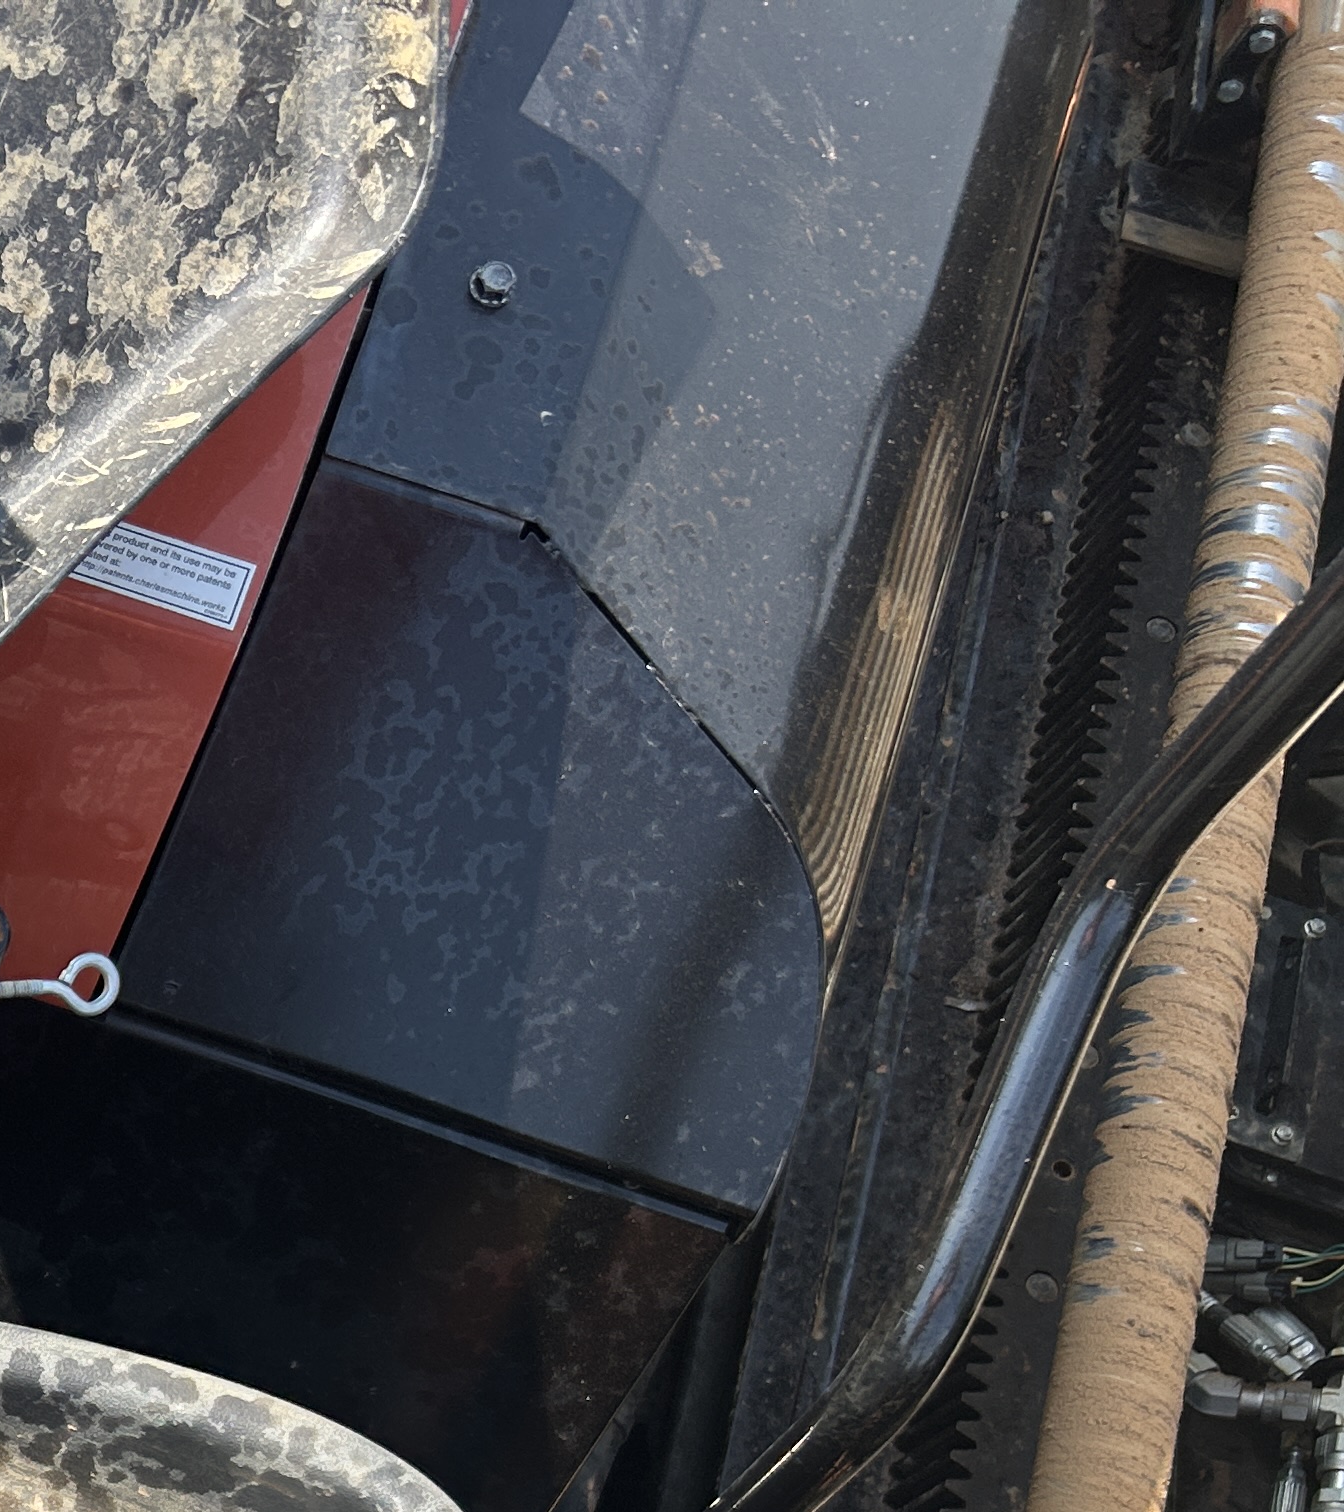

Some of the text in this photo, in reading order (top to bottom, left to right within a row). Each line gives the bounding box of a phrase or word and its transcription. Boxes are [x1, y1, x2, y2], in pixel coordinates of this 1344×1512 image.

[98, 541, 232, 590] vered by one or more patents
[112, 533, 149, 550] product
[150, 546, 169, 557] and
[170, 551, 182, 561] its
[183, 556, 201, 567] use
[202, 562, 222, 576] may
[224, 568, 237, 578] be
